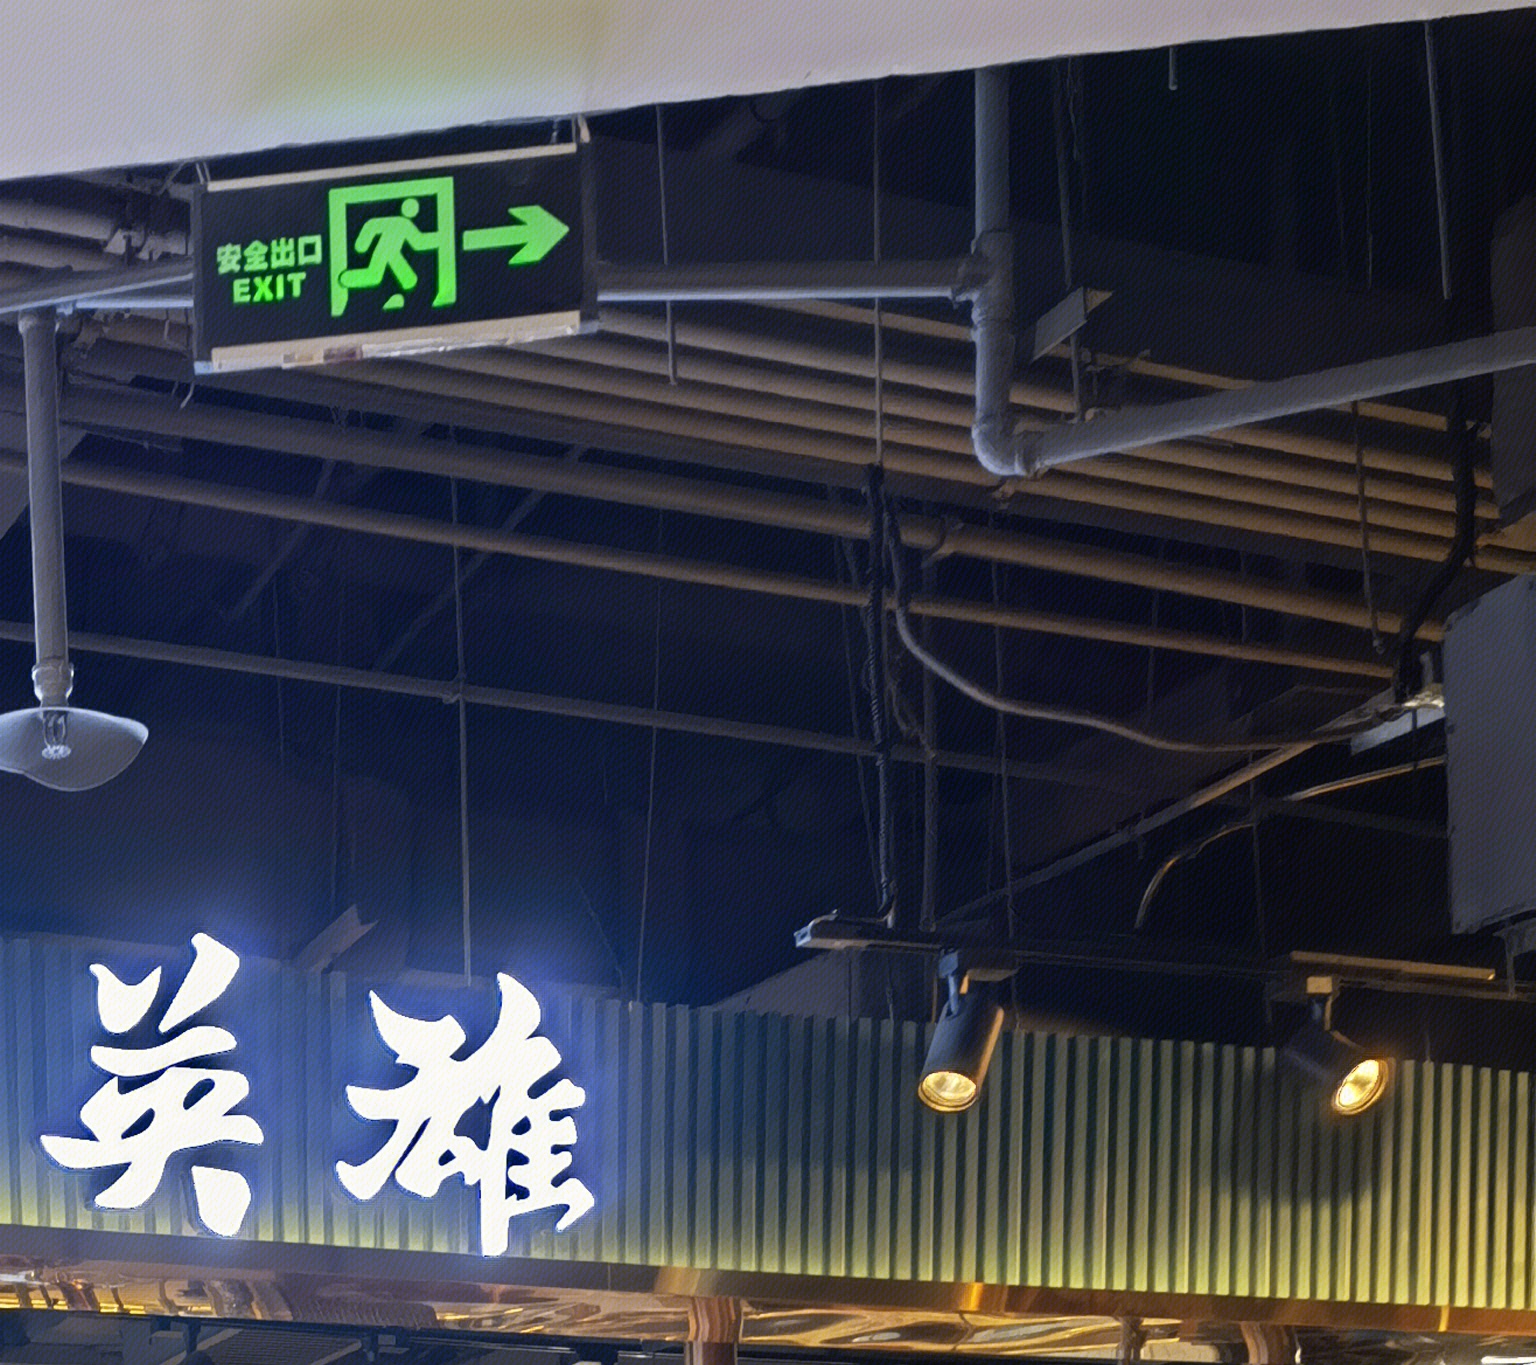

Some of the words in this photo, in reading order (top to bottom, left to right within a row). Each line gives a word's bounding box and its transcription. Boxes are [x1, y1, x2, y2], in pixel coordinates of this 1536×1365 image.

[216, 234, 323, 275] 安全出口
[232, 271, 306, 303] EXIT
